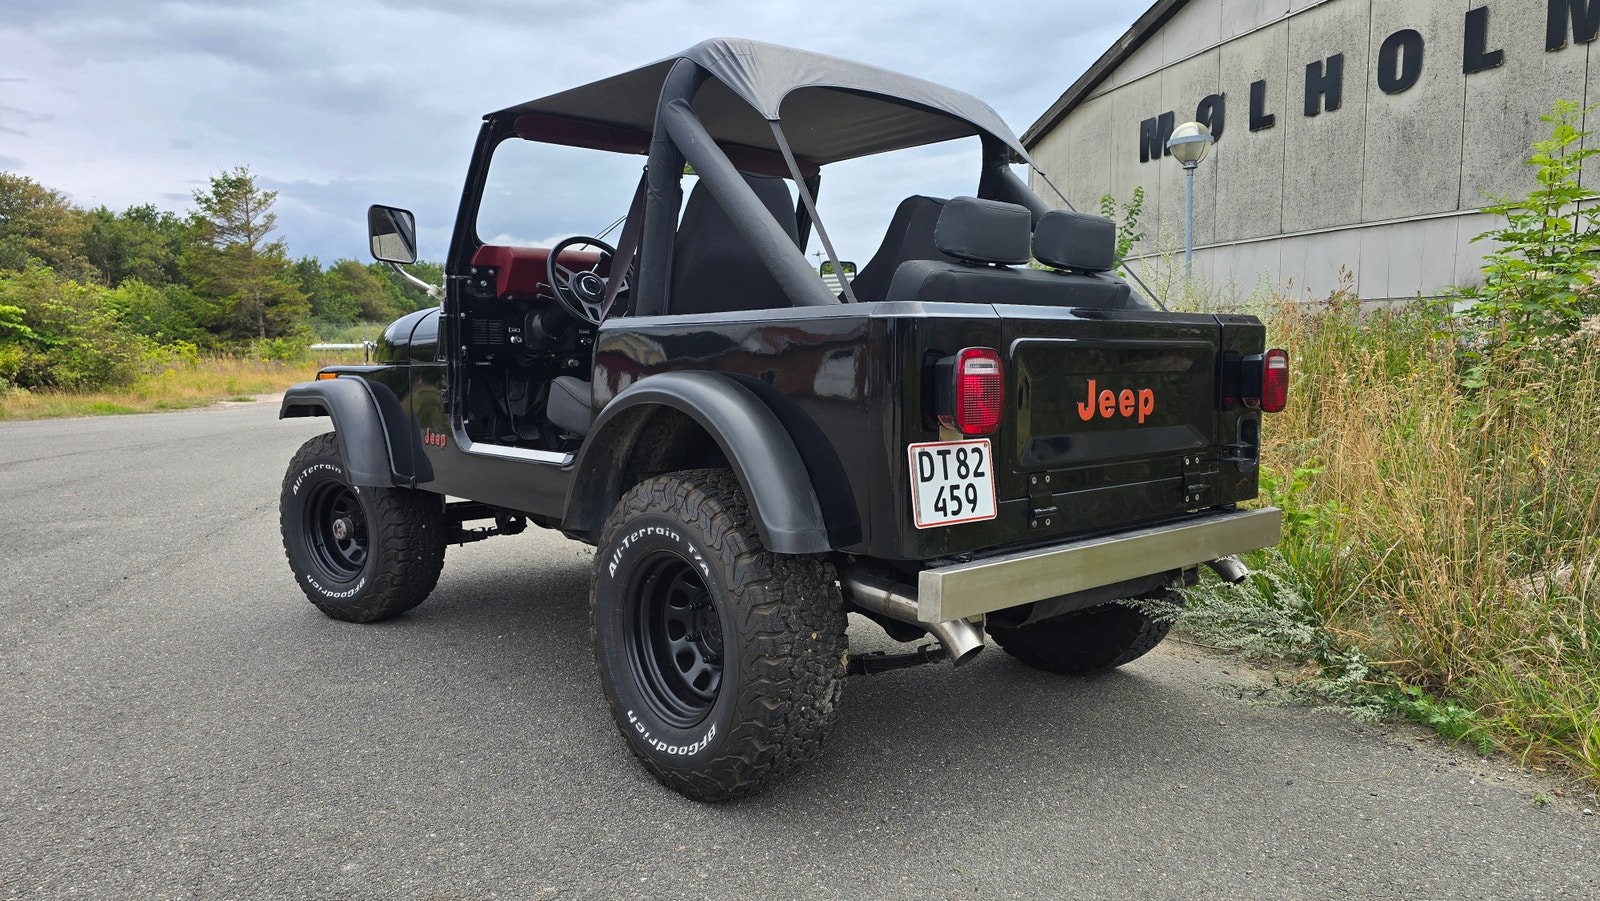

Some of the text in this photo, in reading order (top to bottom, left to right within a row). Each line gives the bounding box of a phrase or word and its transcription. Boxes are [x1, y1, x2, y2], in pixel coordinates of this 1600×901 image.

[1077, 379, 1155, 424] Jeep
[424, 428, 446, 448] Jeep
[293, 463, 342, 495] All-Terrain
[934, 482, 978, 518] 459
[607, 526, 711, 579] All-Terrain T/A
[306, 574, 365, 598] BFGoodrich
[626, 709, 717, 756] BFGoodrich
